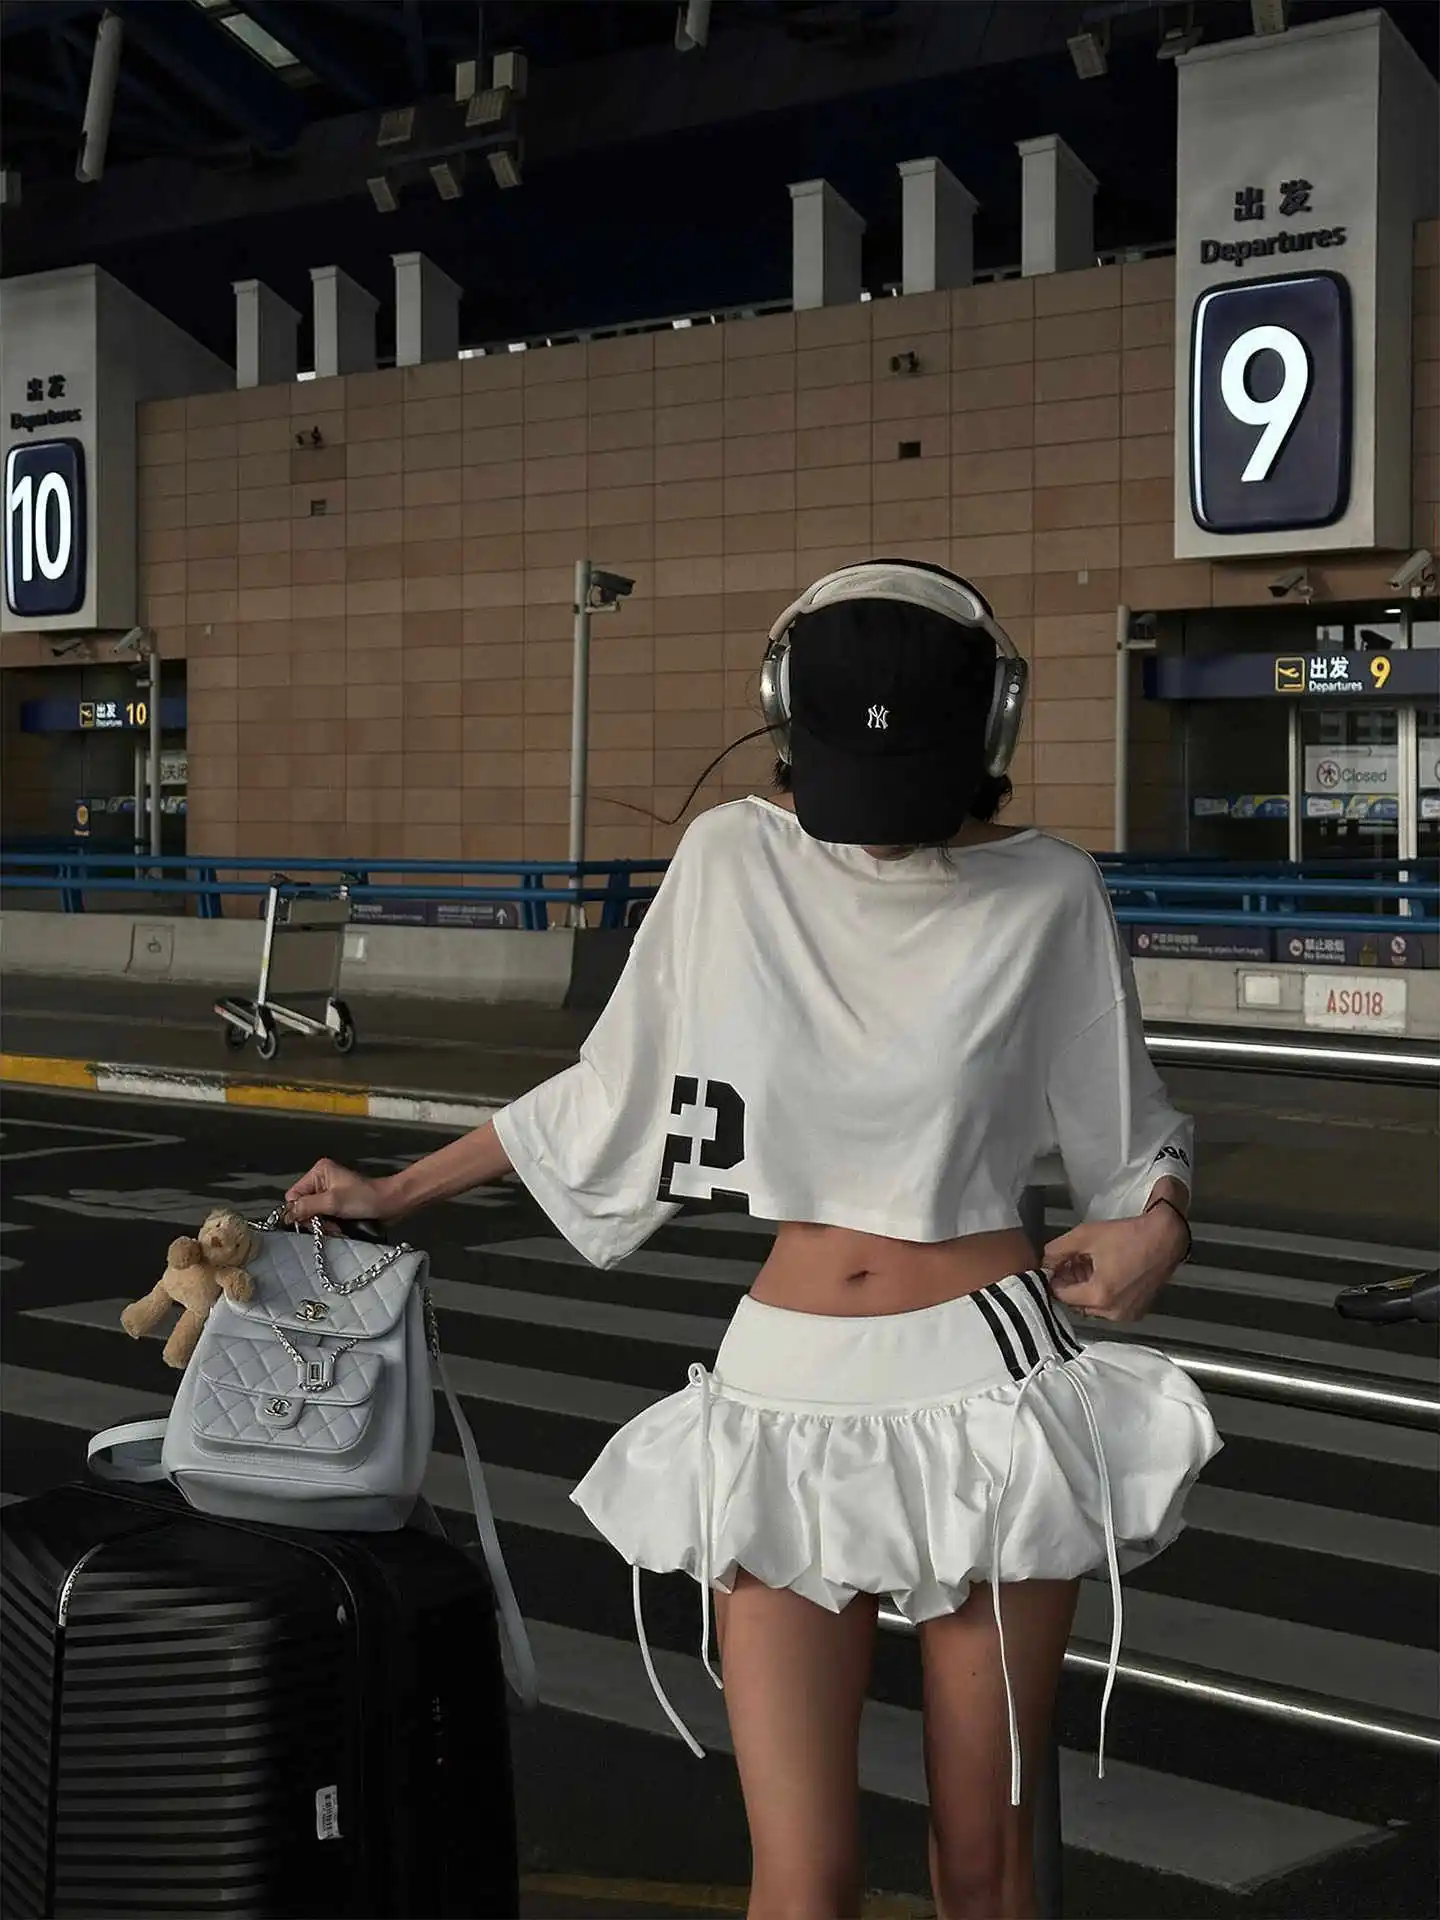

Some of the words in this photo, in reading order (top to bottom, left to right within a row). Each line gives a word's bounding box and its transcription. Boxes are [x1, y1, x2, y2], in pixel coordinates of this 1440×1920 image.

[1234, 179, 1313, 222] 出发
[1200, 225, 1347, 267] Departures
[1220, 325, 1309, 482] 9
[10, 471, 72, 582] 10
[1310, 655, 1349, 679] 出发
[1370, 655, 1392, 689] 9
[1309, 680, 1364, 694] Departures
[126, 702, 147, 726] 10
[1342, 768, 1388, 783] Closed
[1326, 989, 1385, 1016] AS018
